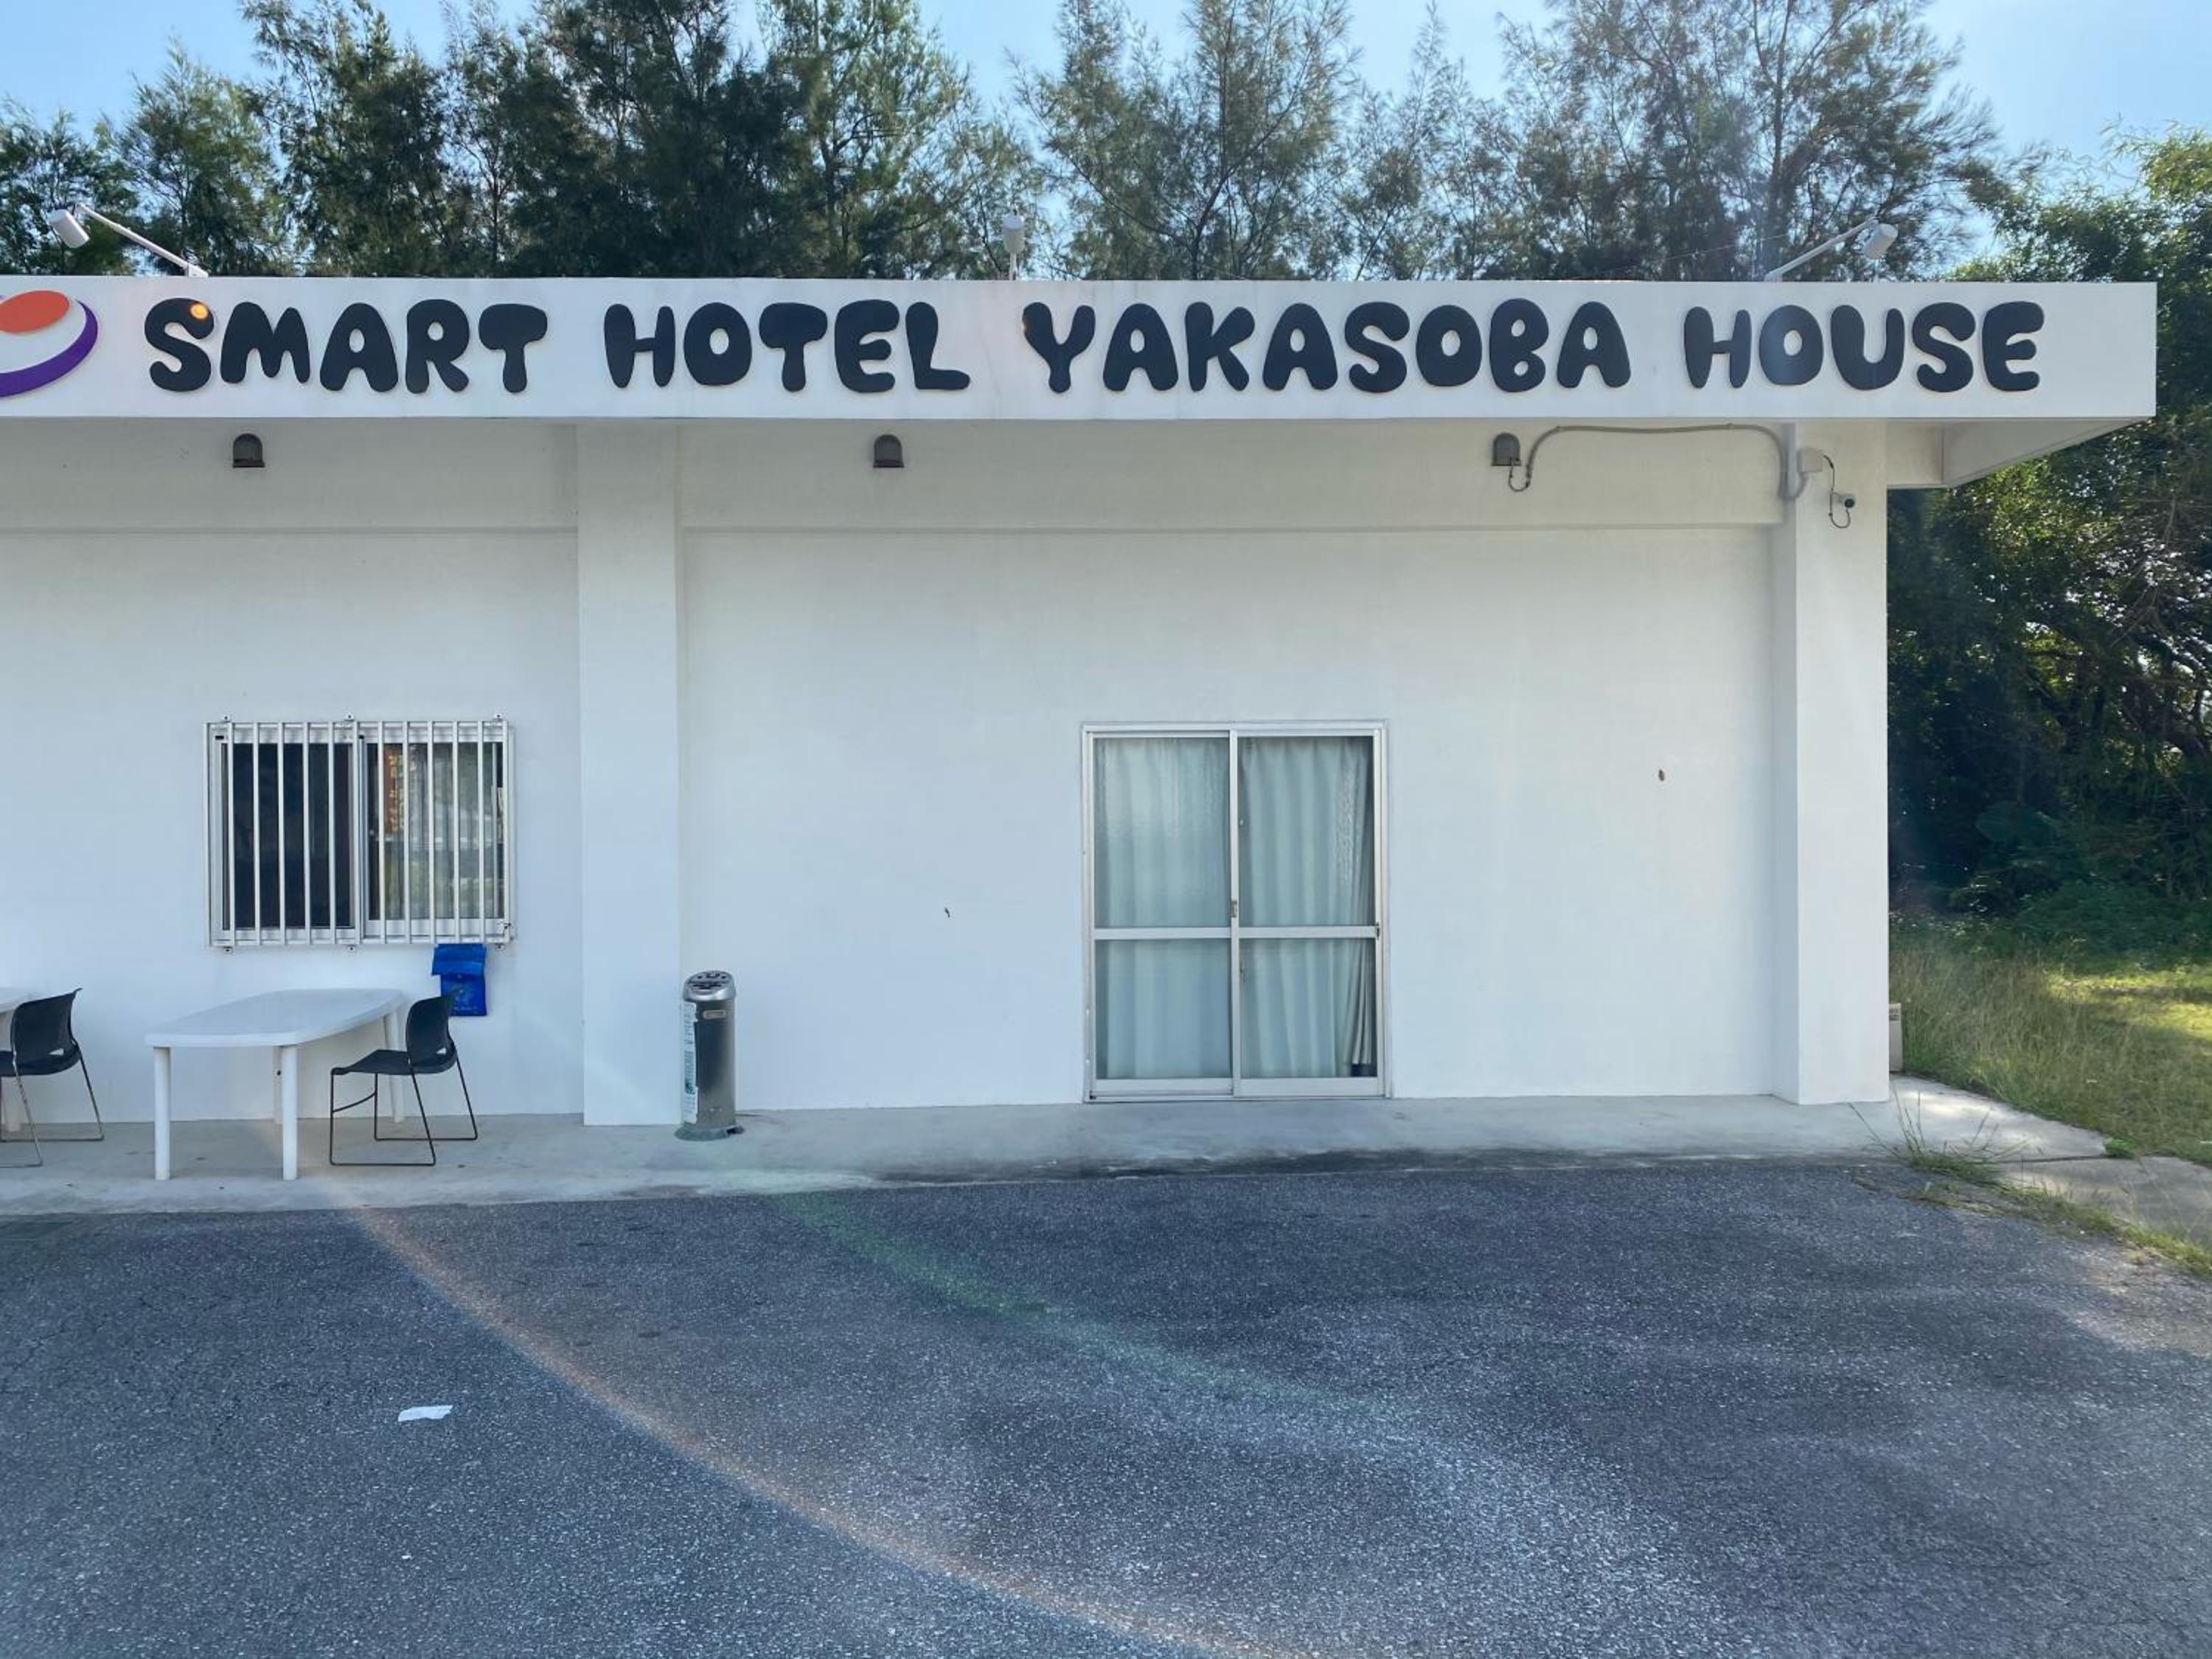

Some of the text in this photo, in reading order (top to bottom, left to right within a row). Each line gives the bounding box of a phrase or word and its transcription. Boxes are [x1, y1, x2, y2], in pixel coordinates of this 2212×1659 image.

[145, 297, 2045, 394] SMART HOTEL YAKASOBA HOUSE
